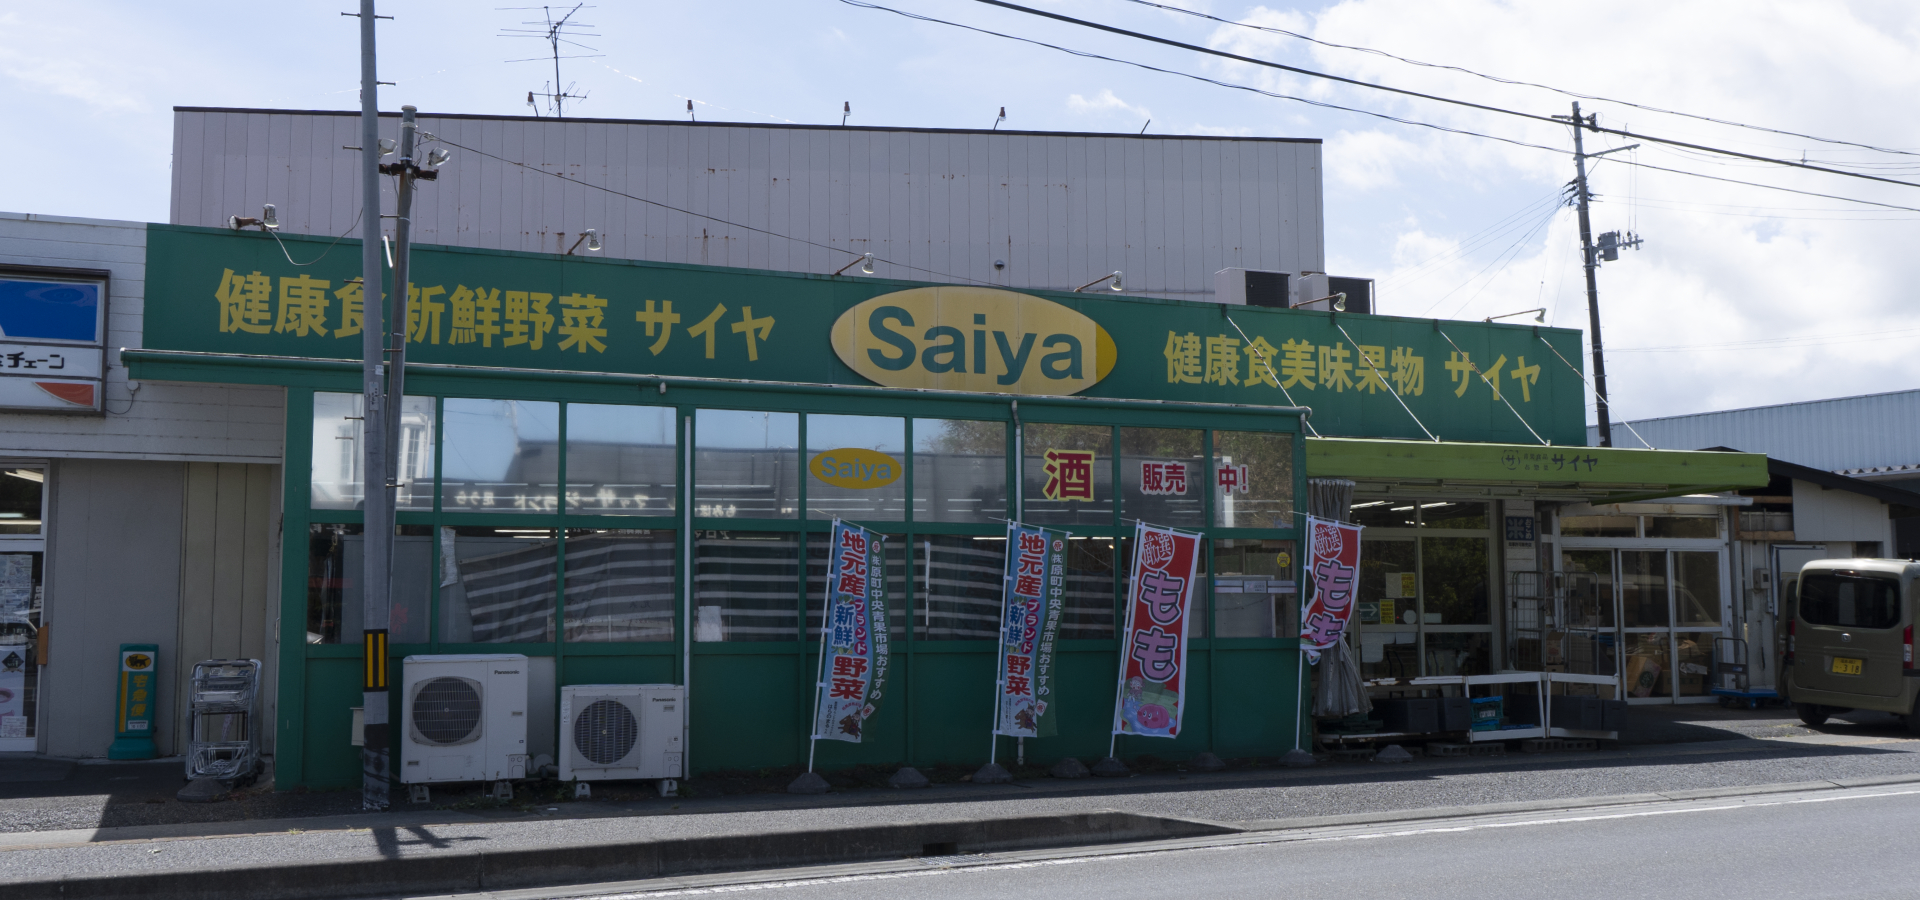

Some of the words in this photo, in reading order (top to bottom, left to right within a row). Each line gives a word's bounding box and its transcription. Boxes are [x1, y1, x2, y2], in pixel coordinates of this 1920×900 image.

[215, 267, 608, 353] 健康食新鮮野菜
[636, 299, 775, 361] サイヤ
[0, 351, 65, 369] チェーン
[866, 304, 1083, 385] Saiya
[1163, 329, 1425, 396] 健康食美味果物
[1444, 351, 1541, 403] サイヤ
[821, 455, 893, 486] Saiya
[1043, 449, 1095, 500] 酒
[1142, 463, 1186, 495] 販売
[1551, 453, 1598, 472] サイヤ
[838, 530, 867, 598] 地元産
[1014, 532, 1046, 597] 地元産
[833, 603, 855, 647] 新鮮
[855, 600, 867, 655] ブランド
[1007, 605, 1026, 646] 新鮮
[1022, 599, 1040, 654] ブランド
[1134, 570, 1183, 682] もも
[1309, 560, 1354, 644] もも
[130, 674, 148, 717] 宅急便
[829, 656, 868, 700] 野菜
[1005, 655, 1031, 696] 野菜
